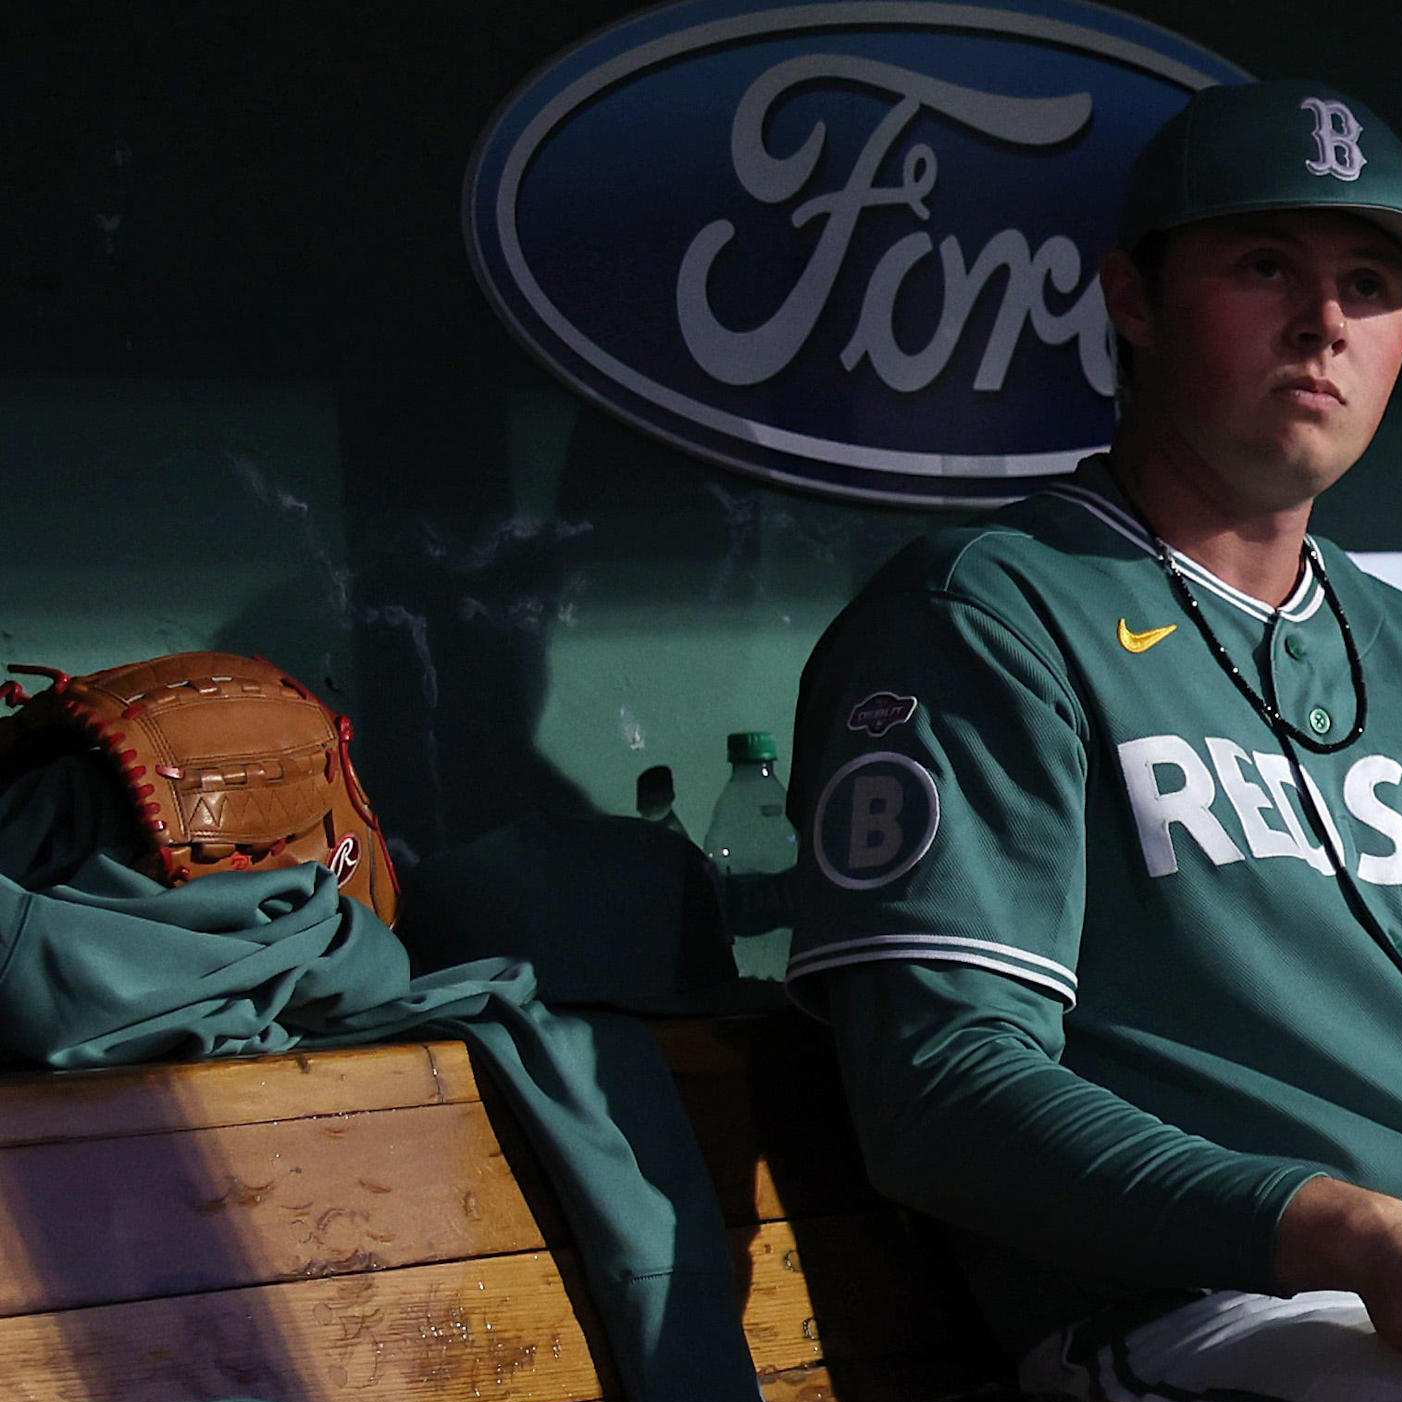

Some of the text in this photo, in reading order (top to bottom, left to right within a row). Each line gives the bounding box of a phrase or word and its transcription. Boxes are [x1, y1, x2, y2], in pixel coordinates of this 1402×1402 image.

[1301, 97, 1367, 181] B
[848, 776, 904, 869] B
[1117, 735, 1347, 878] RED
